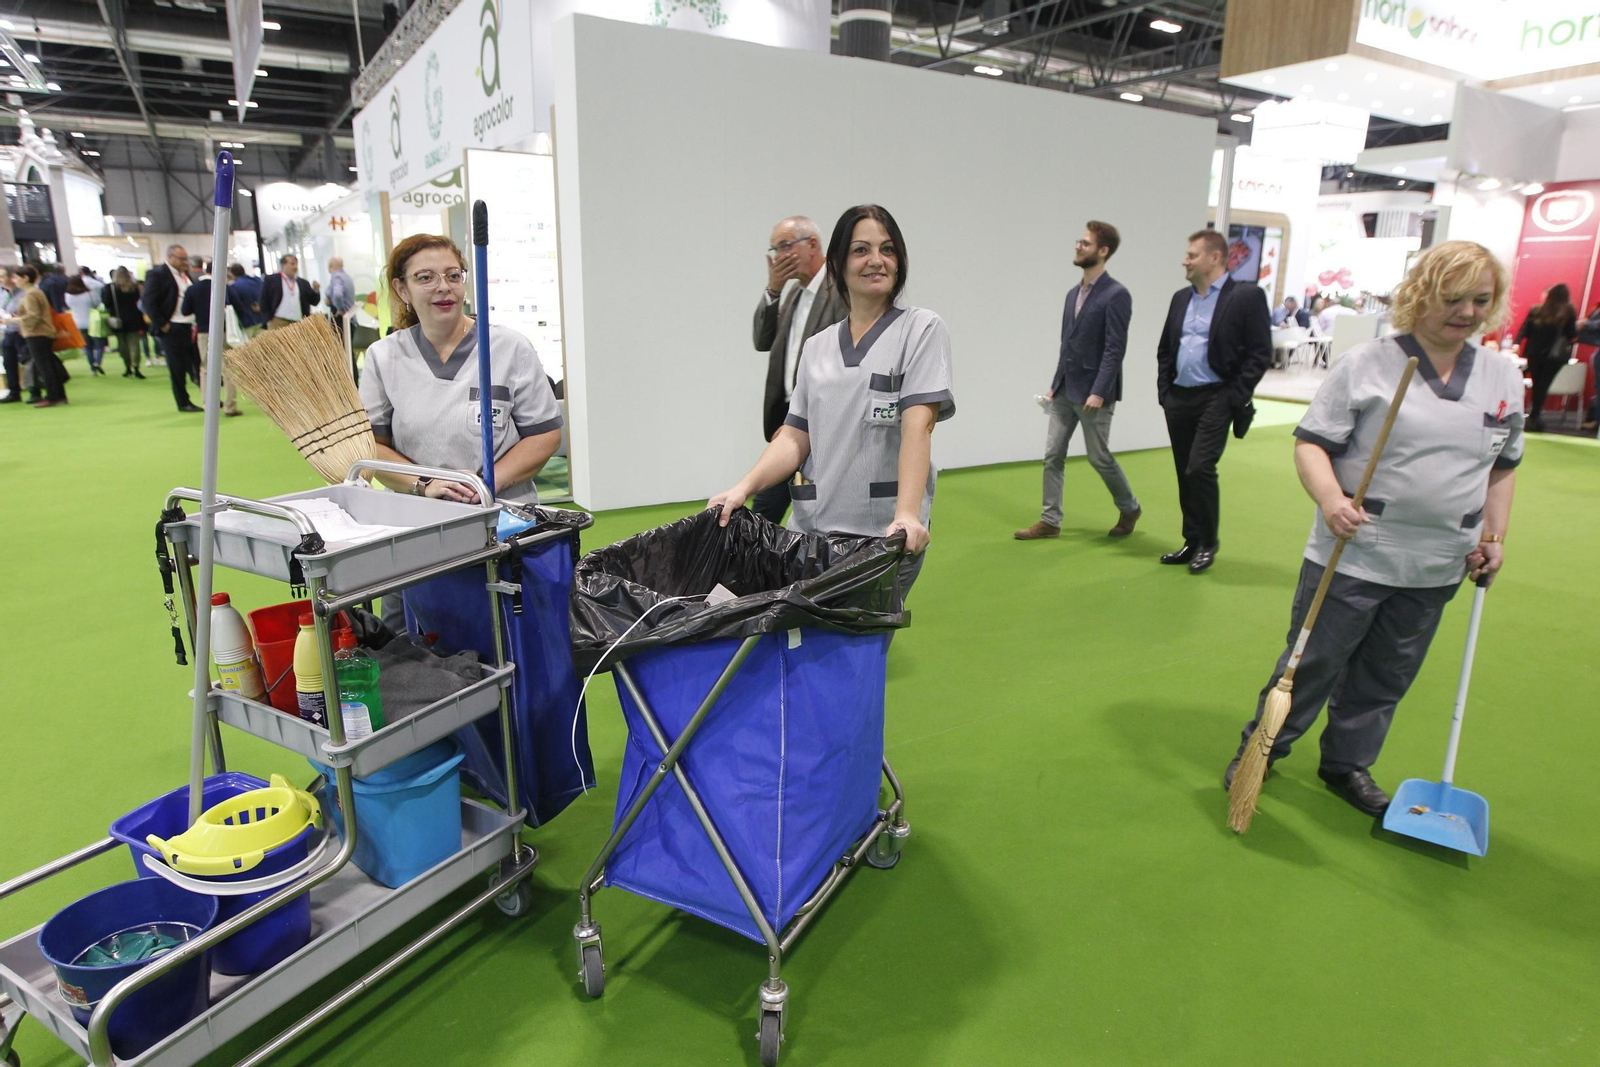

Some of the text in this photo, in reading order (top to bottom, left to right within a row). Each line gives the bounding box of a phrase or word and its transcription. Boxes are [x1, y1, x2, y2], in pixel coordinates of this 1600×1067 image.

[1519, 12, 1600, 51] hor
[473, 92, 513, 143] agrocolor
[873, 407, 895, 419] FCC
